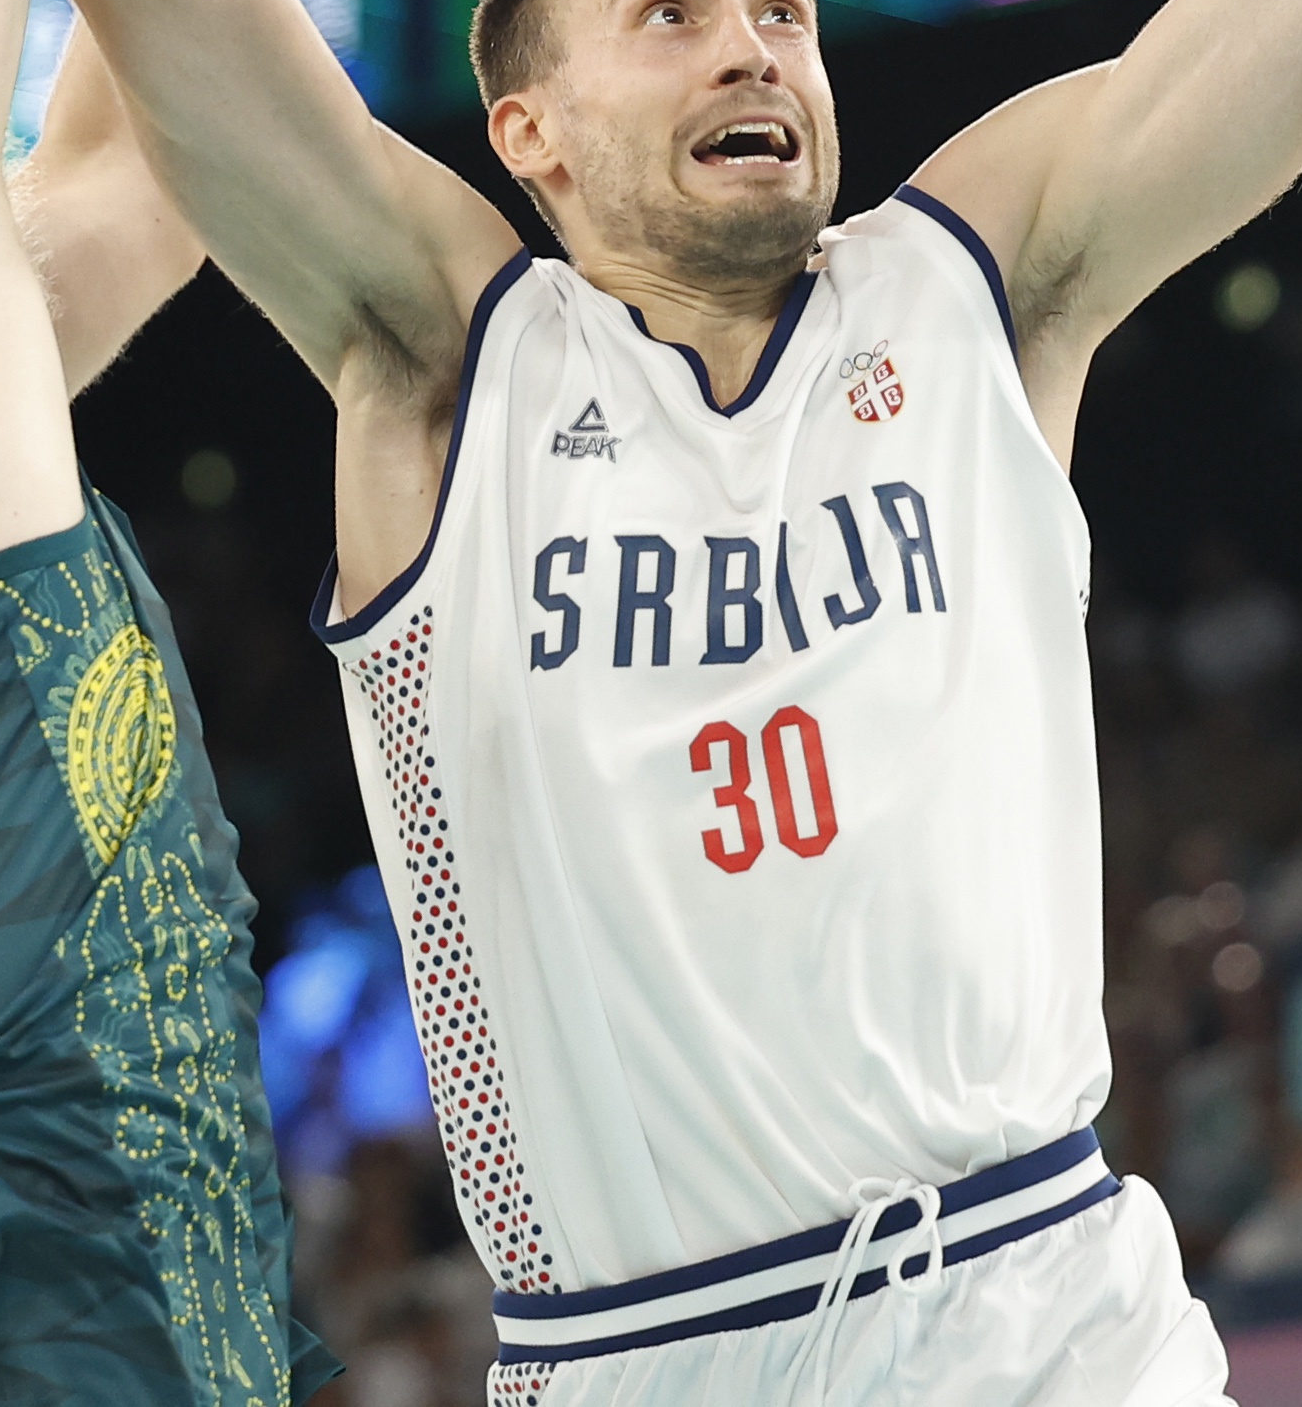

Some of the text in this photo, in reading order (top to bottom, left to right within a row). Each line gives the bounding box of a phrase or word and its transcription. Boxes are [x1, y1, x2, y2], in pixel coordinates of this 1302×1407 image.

[550, 431, 622, 463] PEAK
[530, 480, 947, 672] SRBIJA
[688, 705, 839, 874] 30
